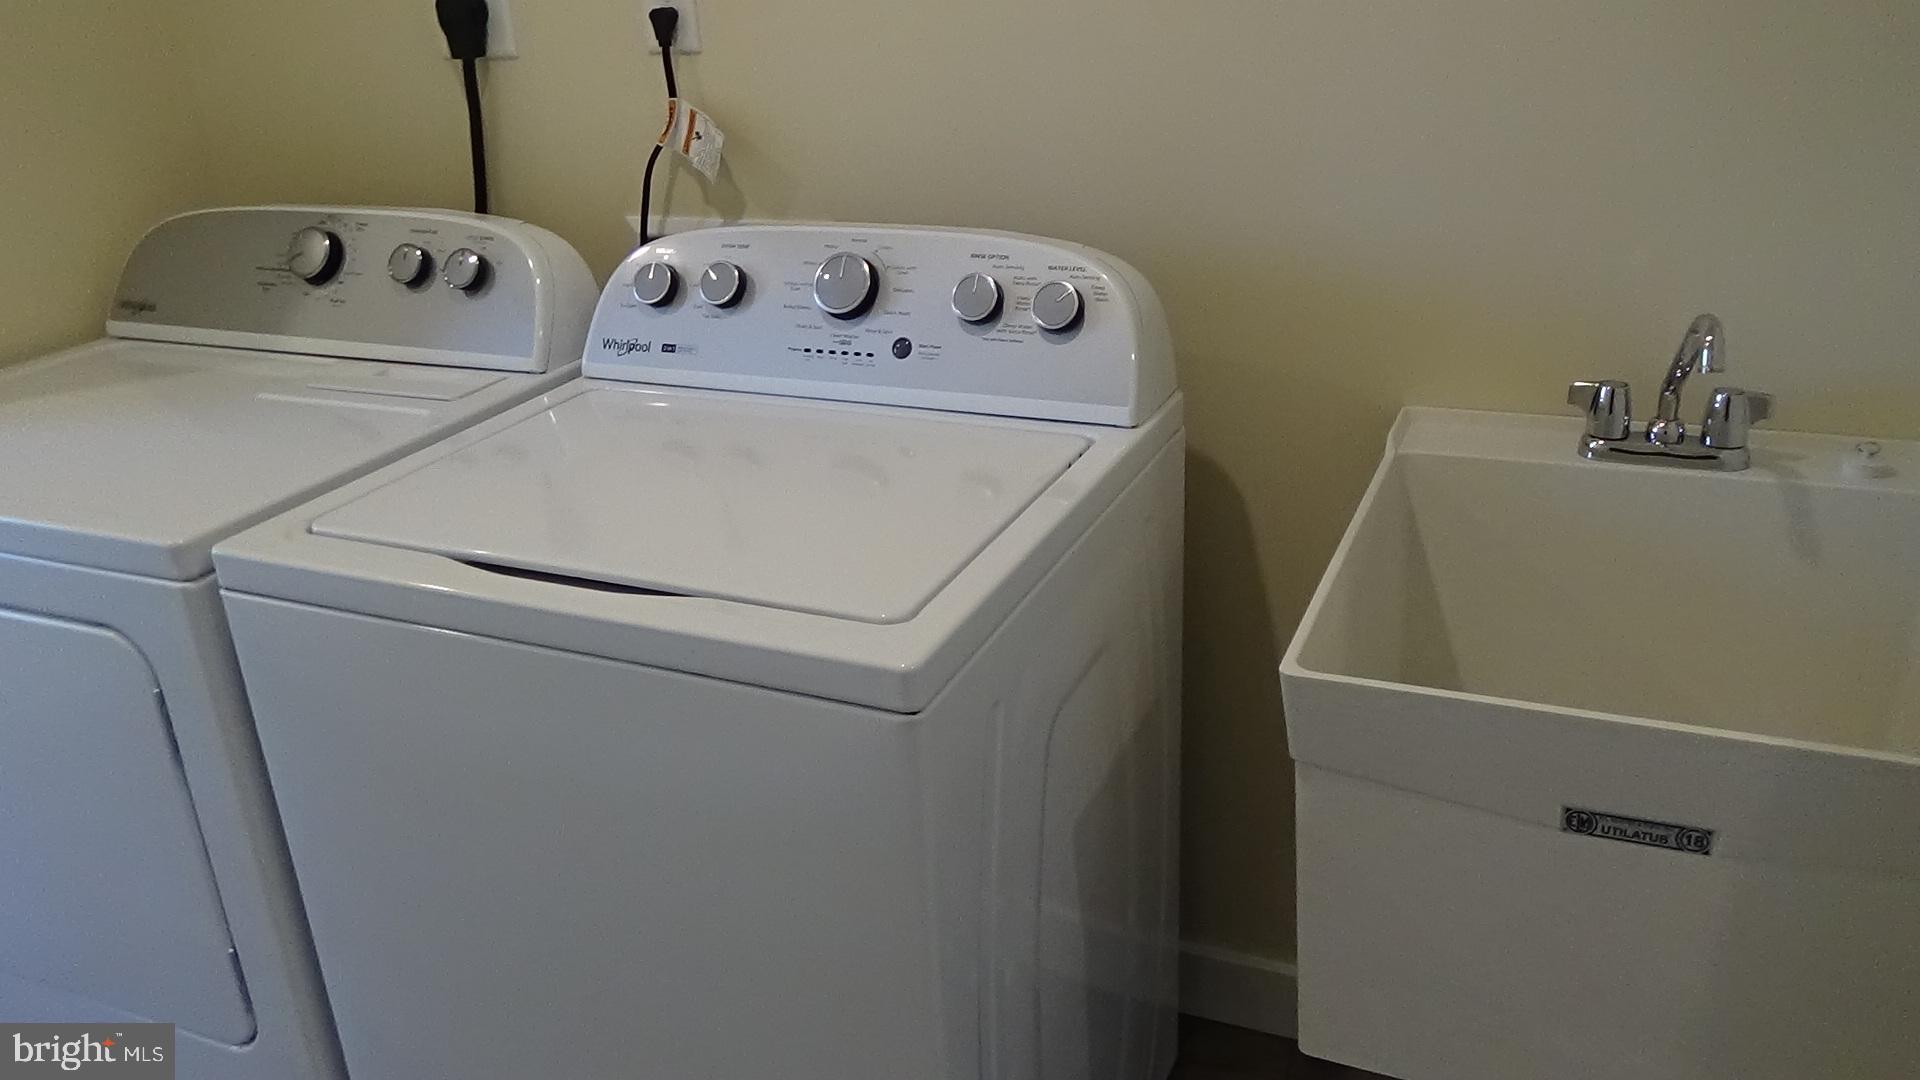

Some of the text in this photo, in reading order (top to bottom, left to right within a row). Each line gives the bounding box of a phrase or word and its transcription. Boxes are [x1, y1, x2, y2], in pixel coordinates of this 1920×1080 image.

[602, 337, 651, 356] Whirlpool
[1601, 825, 1668, 844] UTILATUB
[1685, 833, 1704, 847] 18
